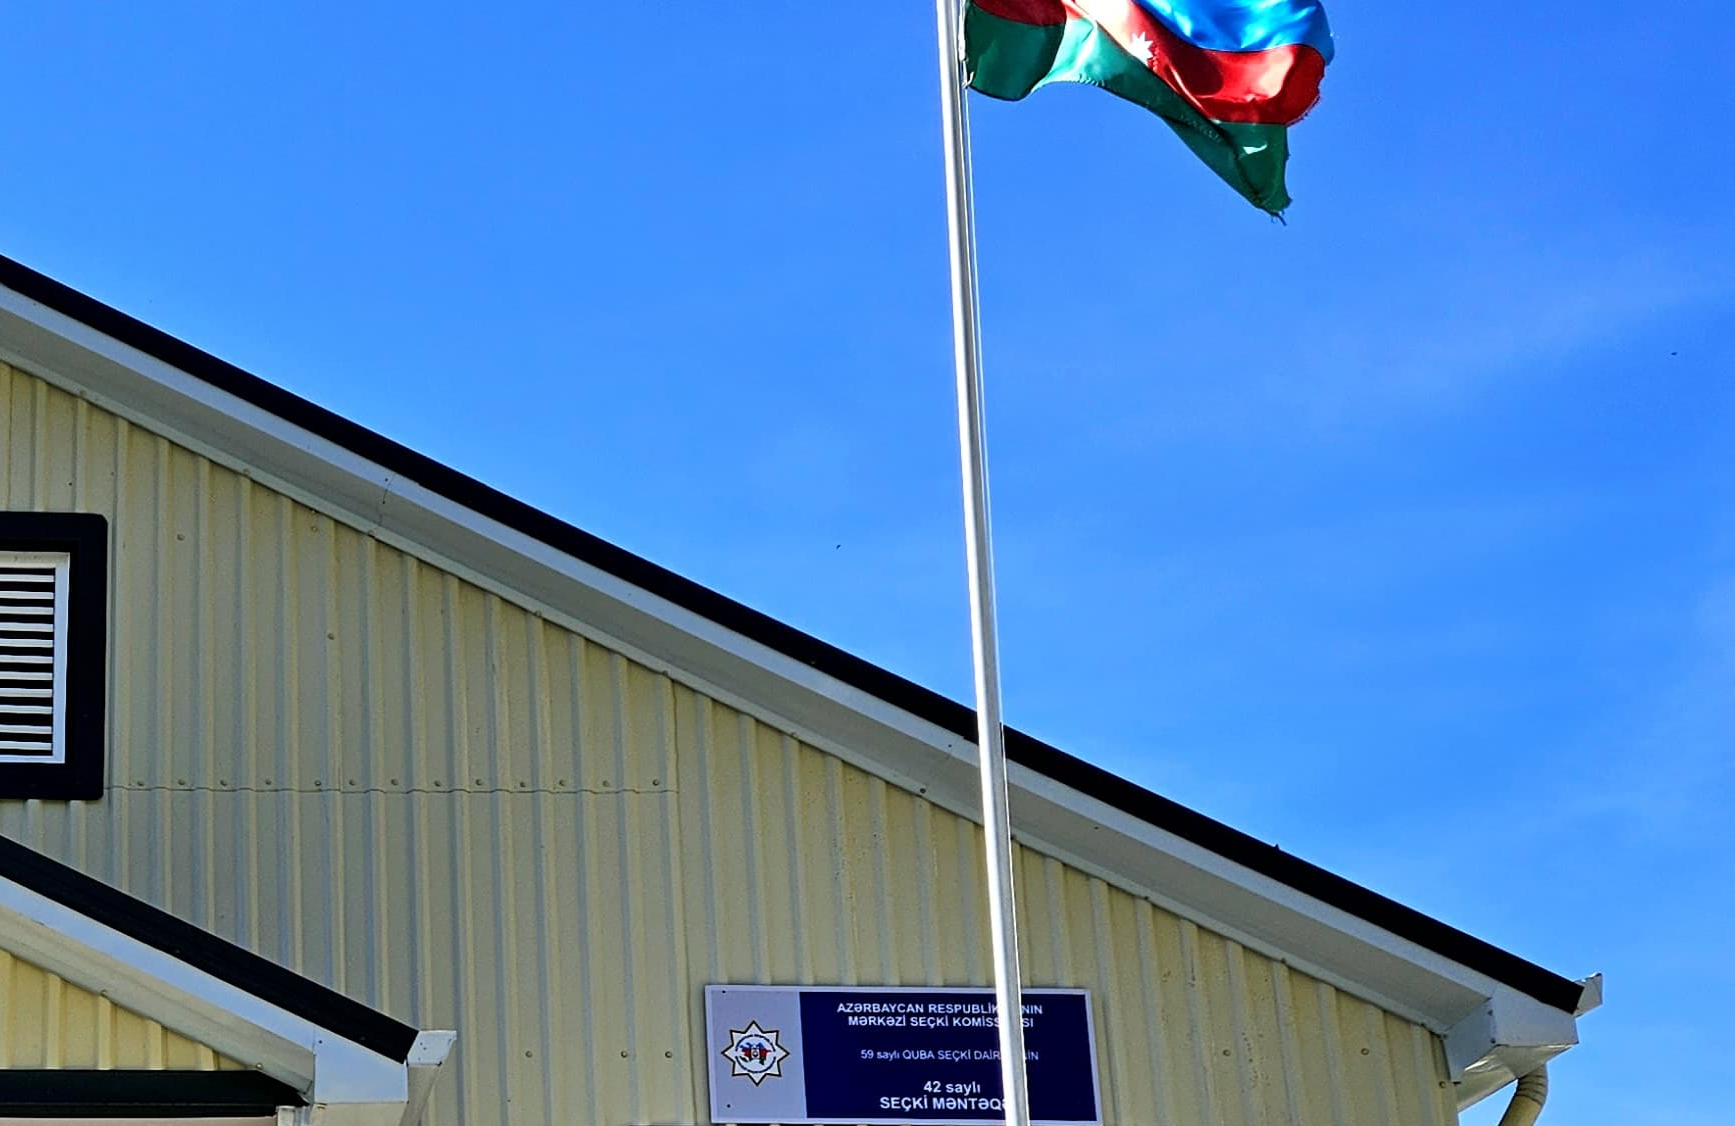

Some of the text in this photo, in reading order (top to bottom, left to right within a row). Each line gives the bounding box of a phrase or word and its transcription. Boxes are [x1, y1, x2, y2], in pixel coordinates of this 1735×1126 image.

[837, 1002, 1043, 1015] AZƏRBAYCAN RESPUBLİKNIN
[848, 1014, 1034, 1029] MƏRKƏZİ SEÇKİ KOMİSSSI
[860, 1049, 1039, 1062] 59 saylı QUBA SEÇKİ DAİRİN
[923, 1080, 981, 1095] 42 saylı
[879, 1094, 928, 1112] SEÇKİ
